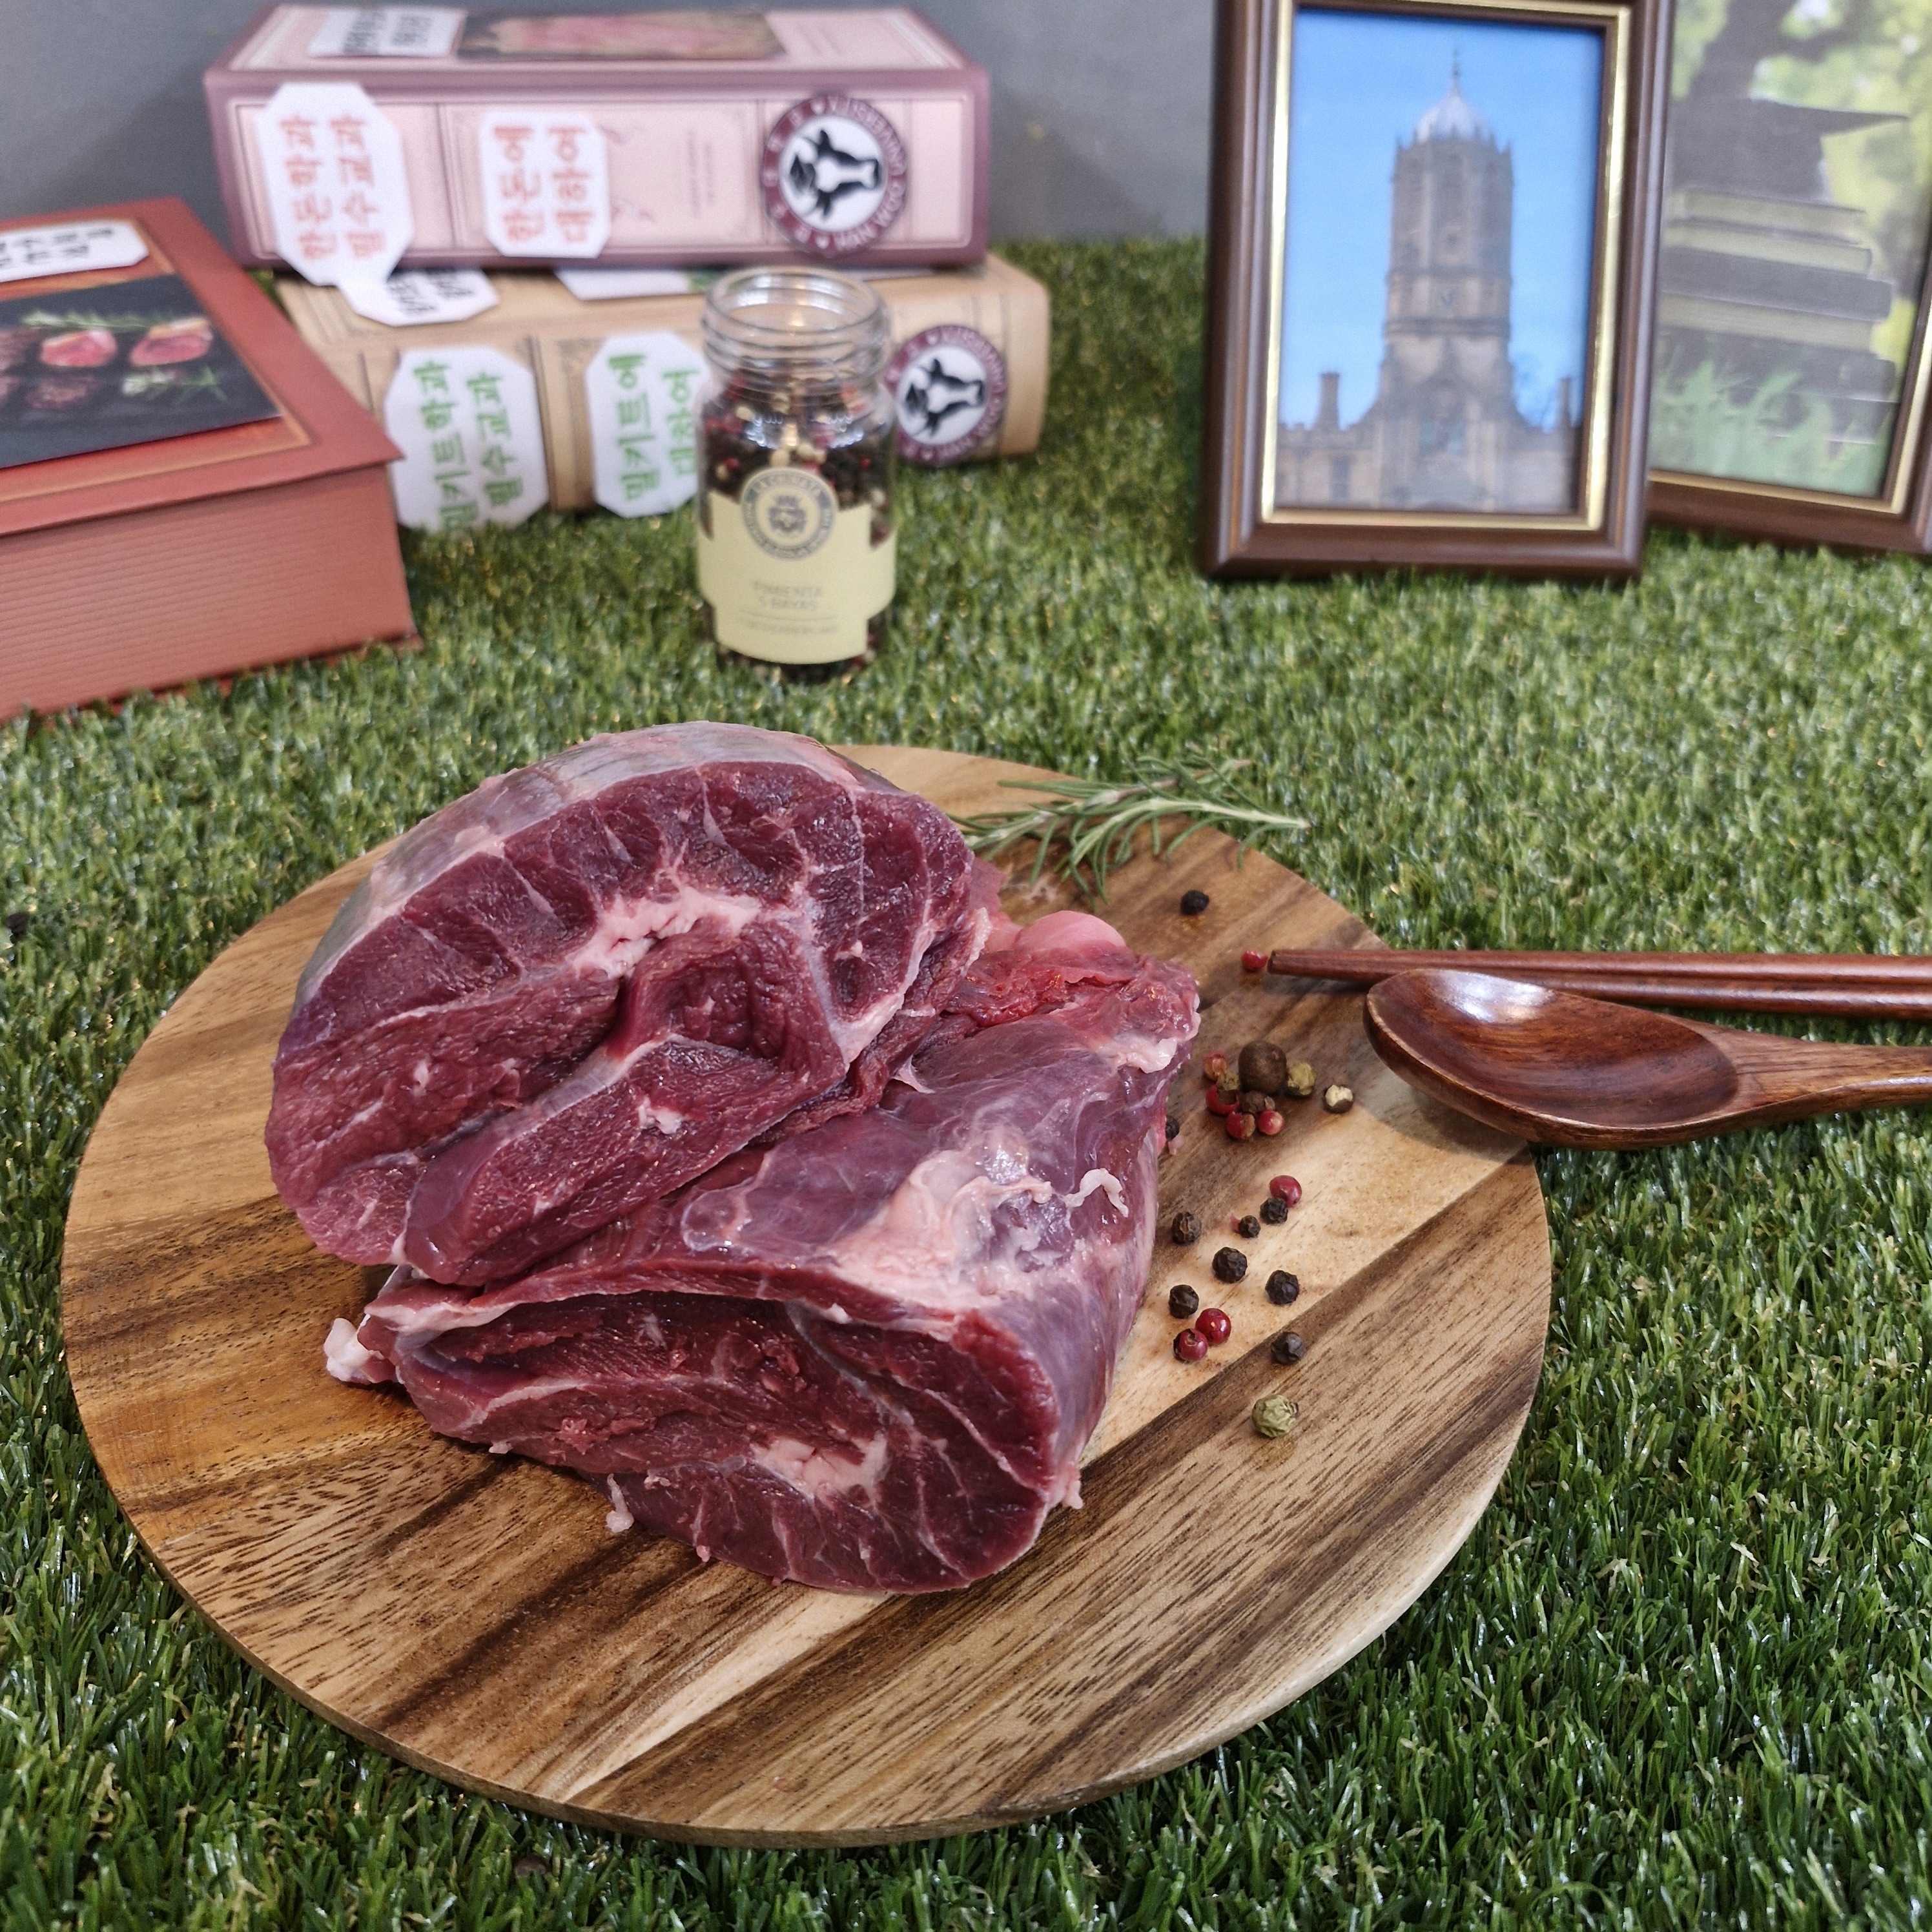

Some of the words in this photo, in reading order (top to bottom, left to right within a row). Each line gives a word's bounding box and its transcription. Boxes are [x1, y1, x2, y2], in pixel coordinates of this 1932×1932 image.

[280, 114, 337, 260] 한돈학과
[329, 114, 385, 259] 필수교과
[494, 126, 544, 242] 한돈에
[548, 127, 593, 243] 대하여
[413, 361, 478, 529] 밀키트학과
[468, 372, 522, 506] 필수교과
[609, 356, 658, 500] 밀키트에
[663, 369, 702, 476] 대하여
